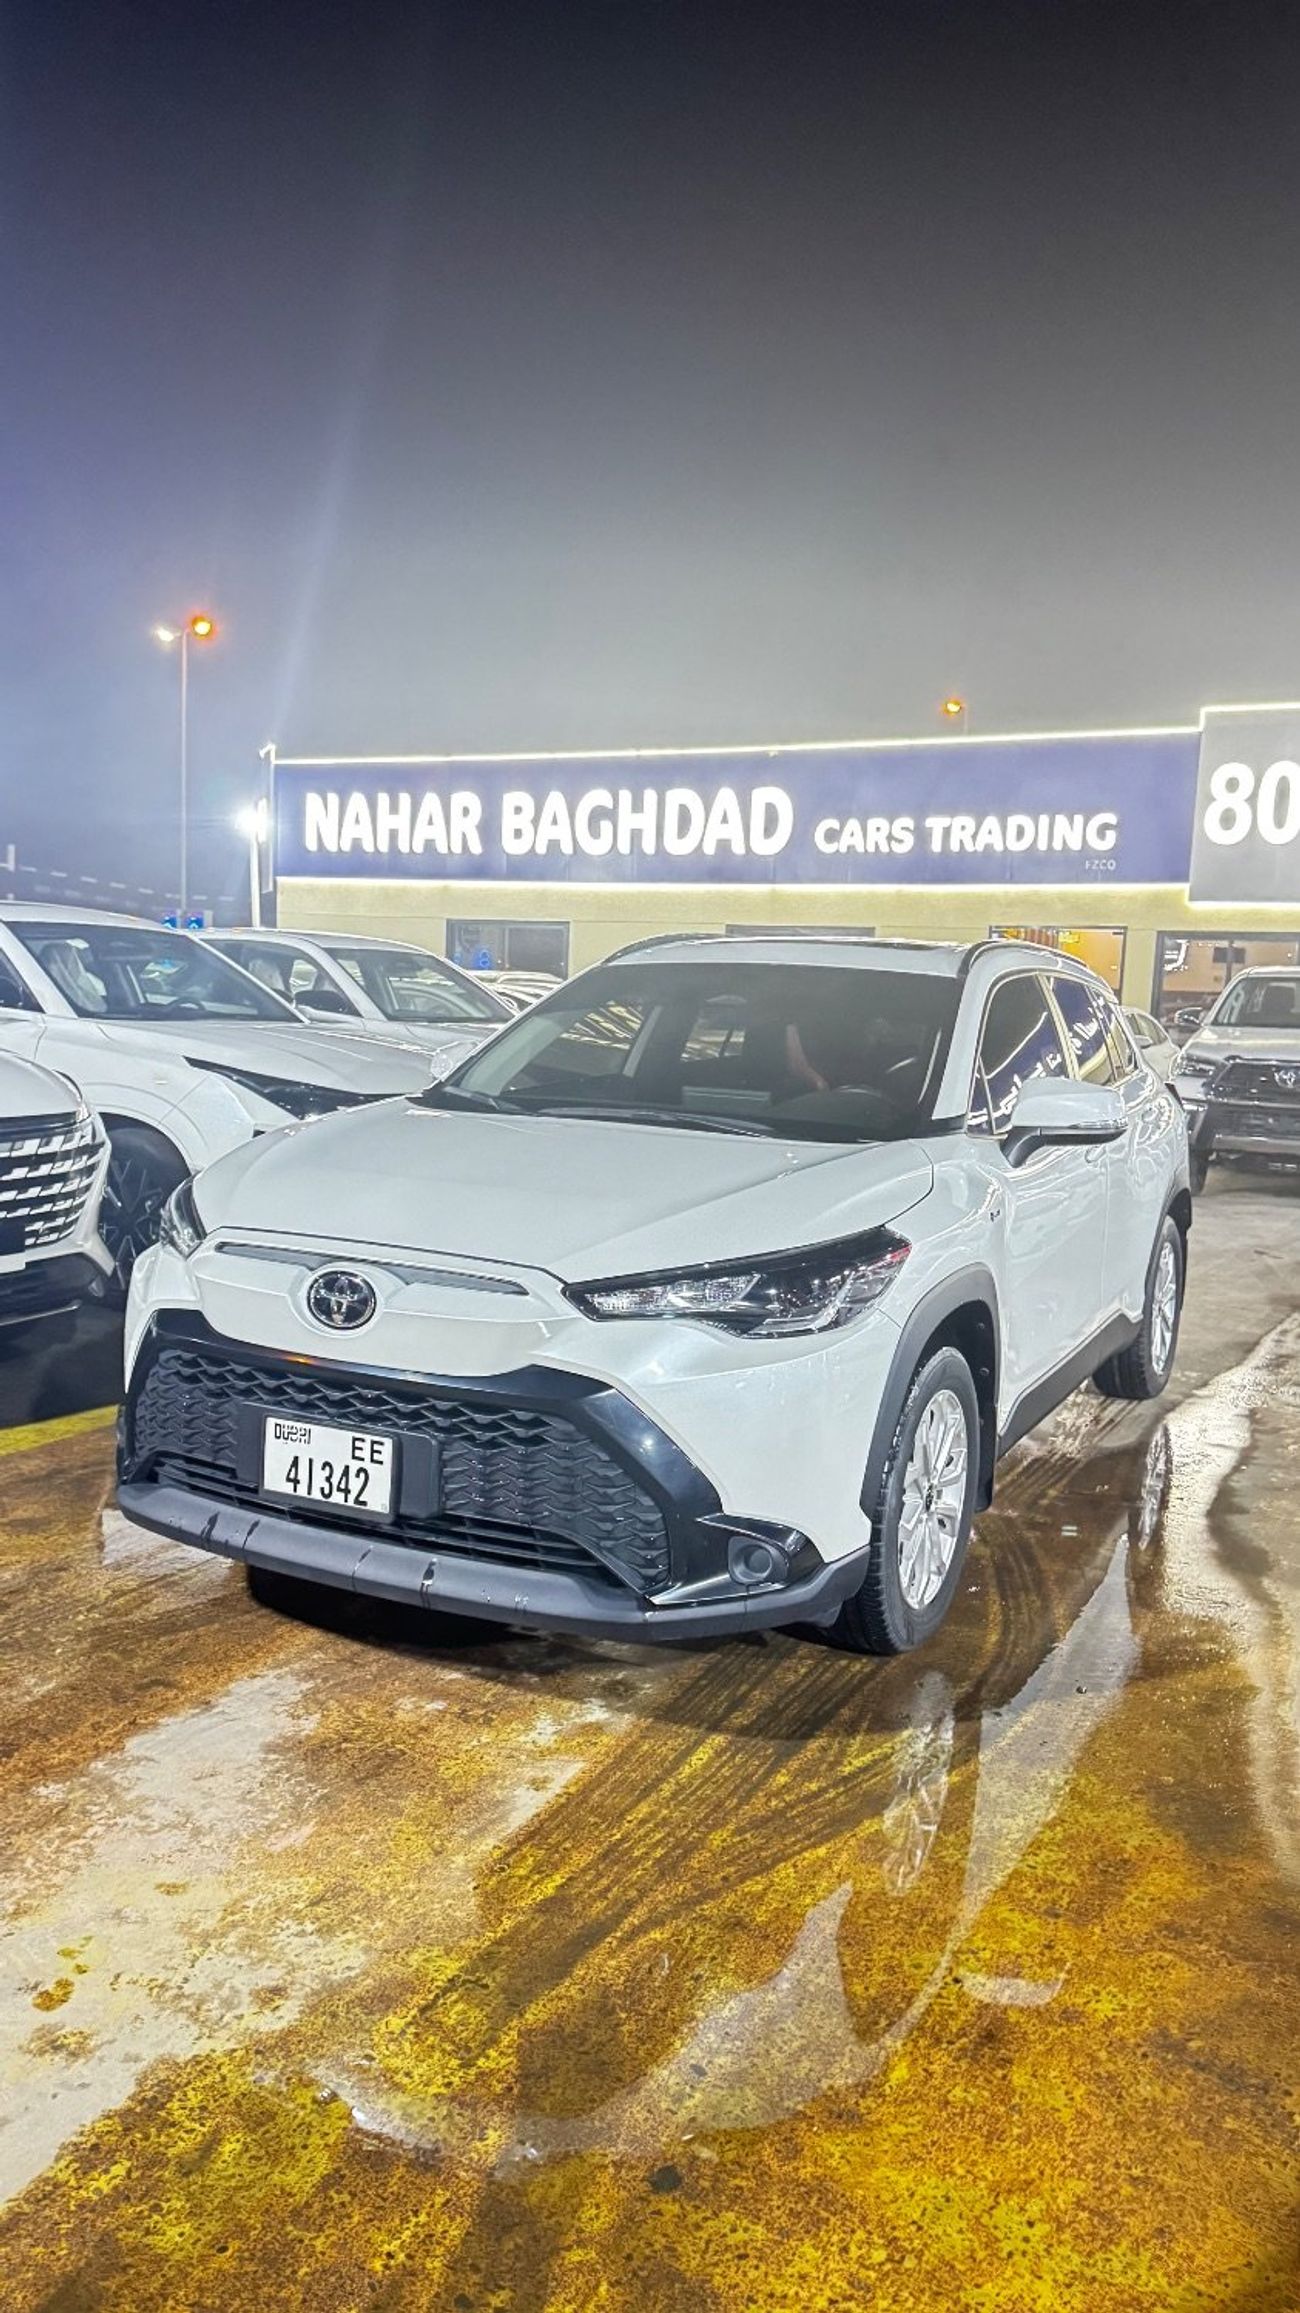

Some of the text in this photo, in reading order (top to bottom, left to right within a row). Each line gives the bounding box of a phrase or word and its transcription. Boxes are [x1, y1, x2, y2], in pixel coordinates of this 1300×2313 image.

[305, 786, 1118, 856] NAHAR BAGHDAD CARS TRADING
[1203, 760, 1300, 845] 80
[1085, 859, 1117, 871] FZCO
[351, 1436, 386, 1465] EE
[285, 1455, 370, 1507] 41342
